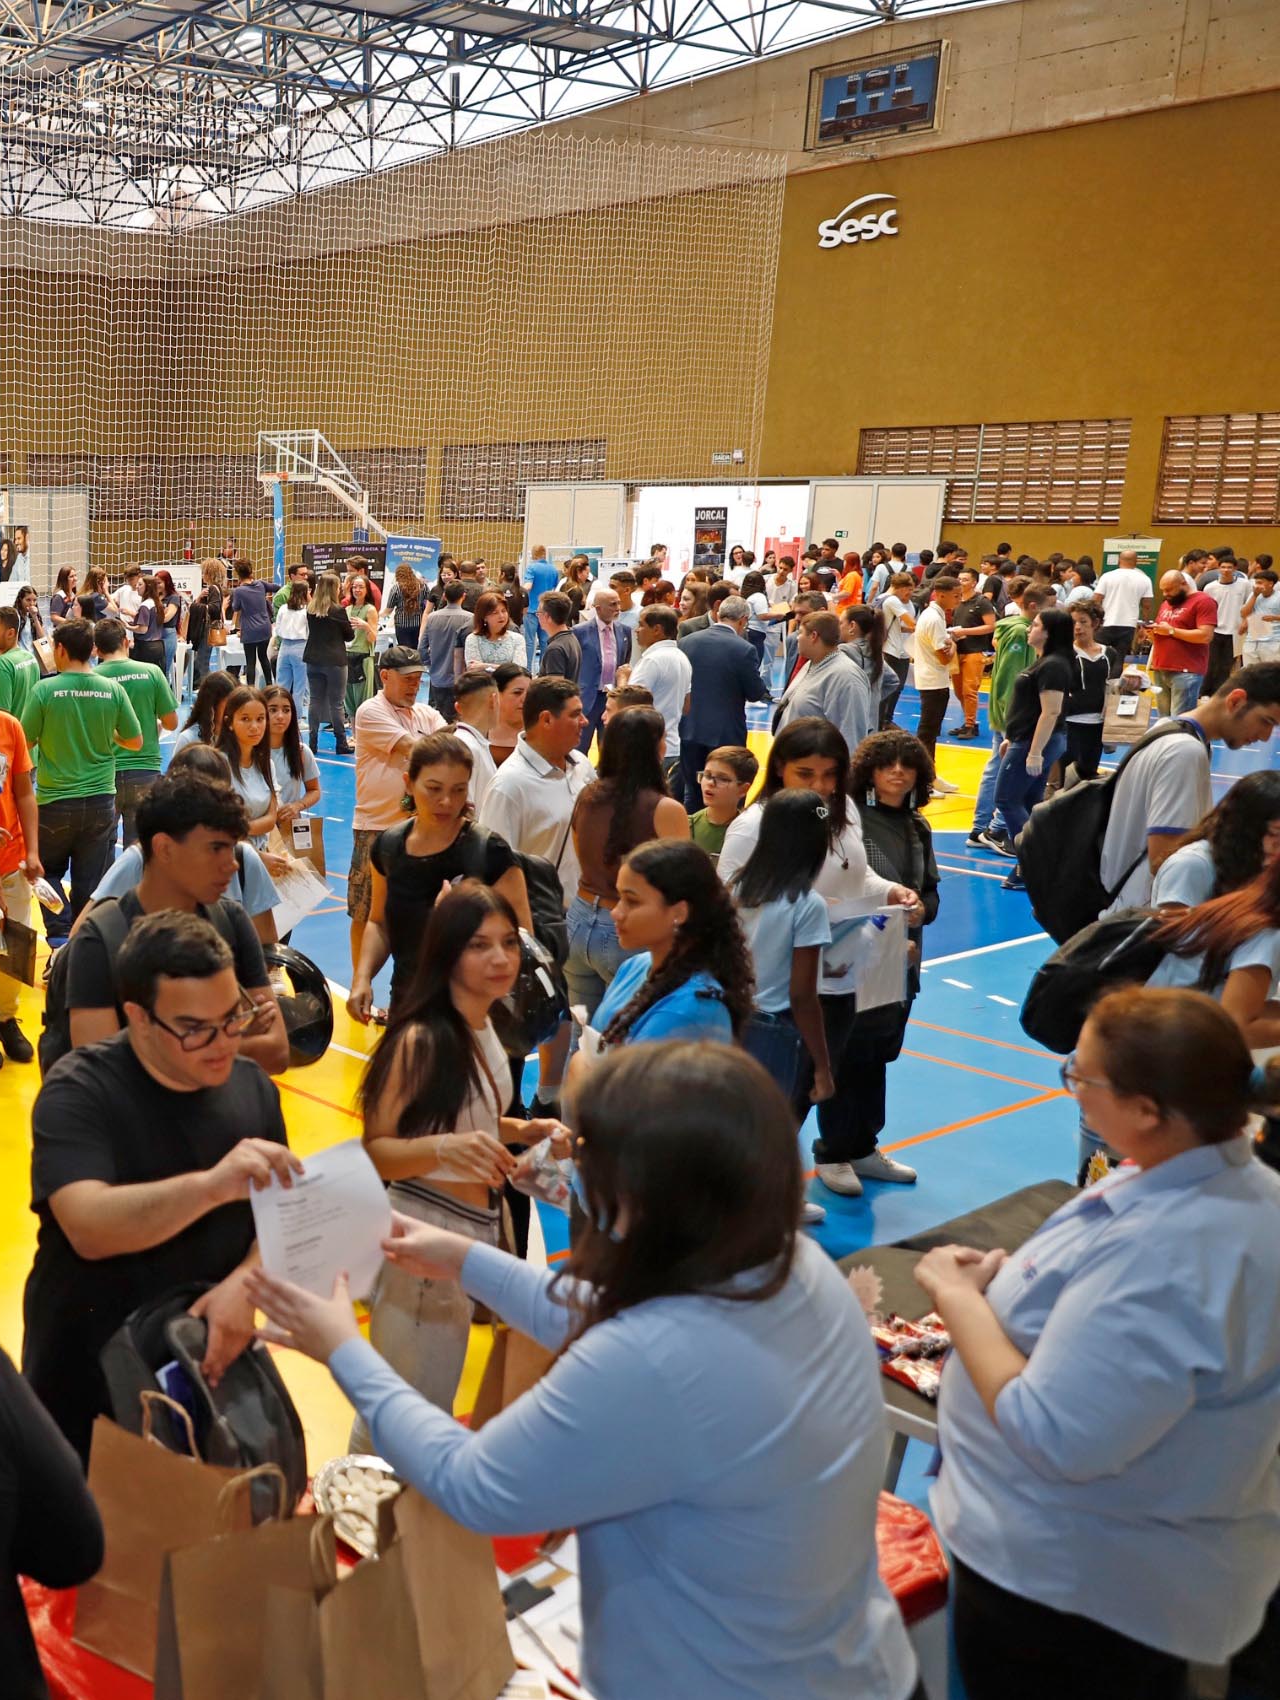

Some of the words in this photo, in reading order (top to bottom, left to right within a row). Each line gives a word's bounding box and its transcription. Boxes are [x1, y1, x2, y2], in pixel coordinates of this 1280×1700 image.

[818, 208, 899, 249] sesc
[695, 510, 726, 521] JORCAL
[53, 690, 69, 698] PET
[70, 690, 112, 699] TRAMPOLIM
